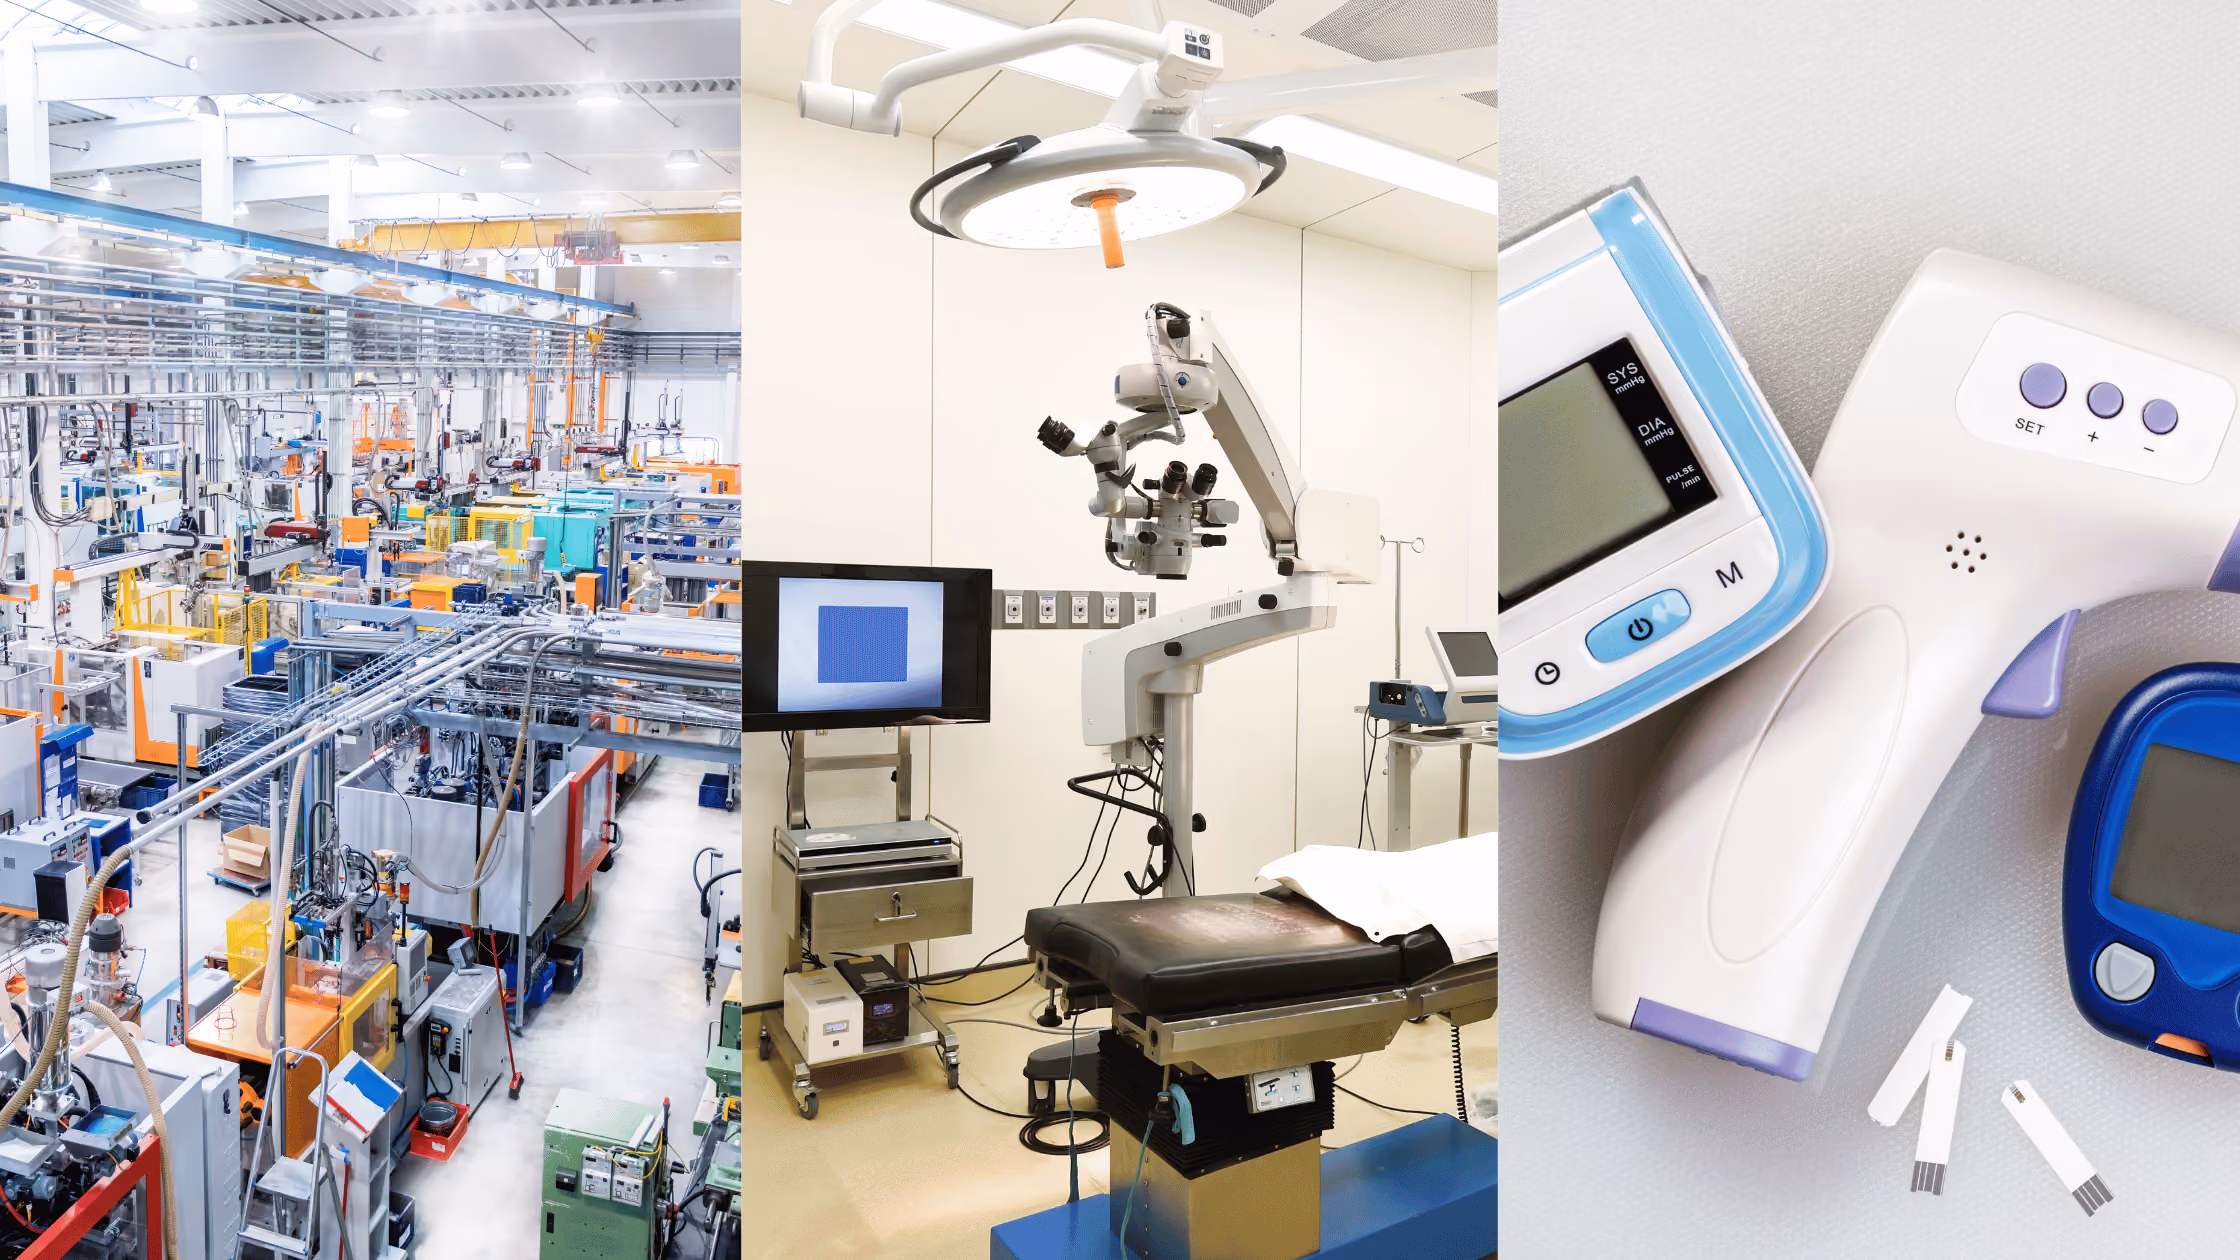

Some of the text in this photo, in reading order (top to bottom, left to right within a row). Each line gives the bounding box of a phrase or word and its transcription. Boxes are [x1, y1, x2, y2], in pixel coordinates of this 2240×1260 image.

[1607, 362, 1638, 385] SYS
[1615, 375, 1645, 394] mmHg
[1638, 417, 1666, 437] DIA
[2015, 417, 2045, 436] SET
[1644, 427, 1675, 446] mmHg
[1666, 464, 1695, 483] PULSE
[1681, 474, 1701, 489] /min
[1715, 561, 1743, 588] M
